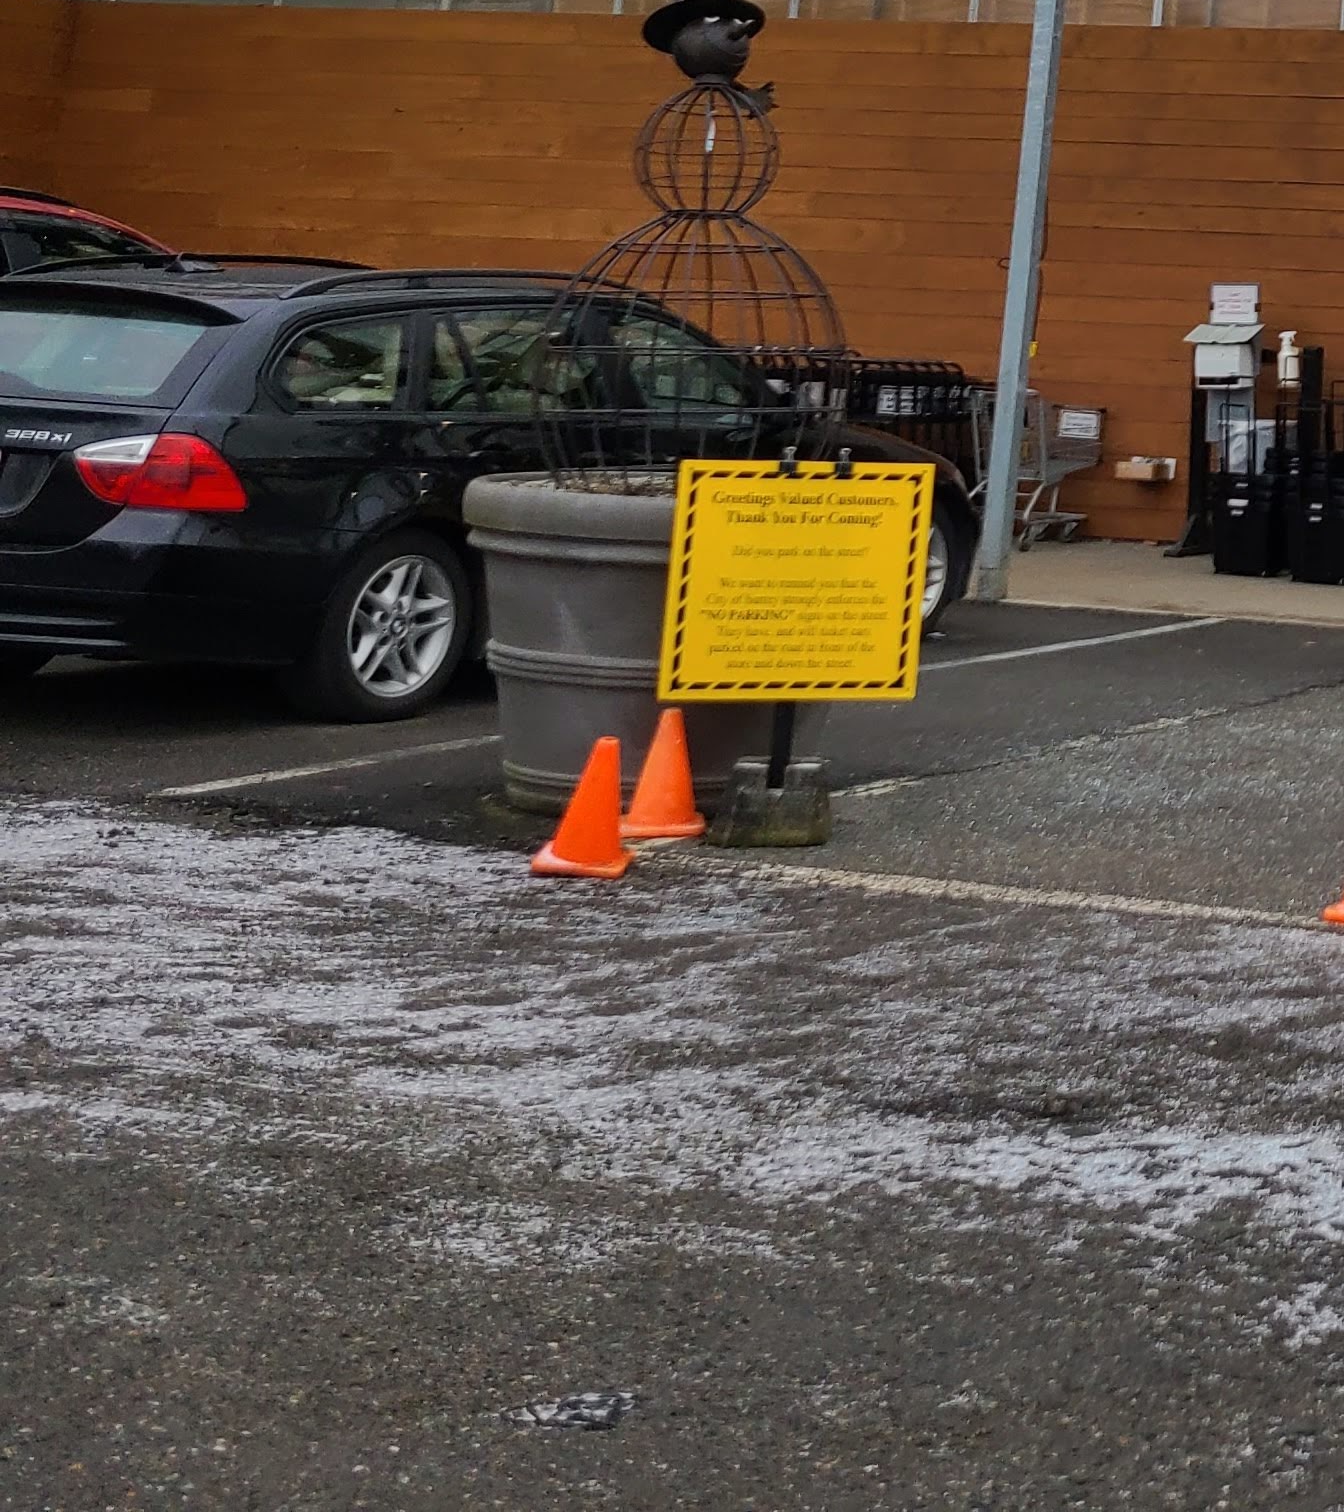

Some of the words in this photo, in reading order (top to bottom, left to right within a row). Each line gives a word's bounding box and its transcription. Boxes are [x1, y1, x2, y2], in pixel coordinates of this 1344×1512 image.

[711, 490, 776, 507] Greetings
[780, 491, 824, 505] Valued
[727, 510, 767, 523] Thank
[774, 510, 797, 524] You
[800, 511, 825, 524] For
[819, 545, 834, 556] the
